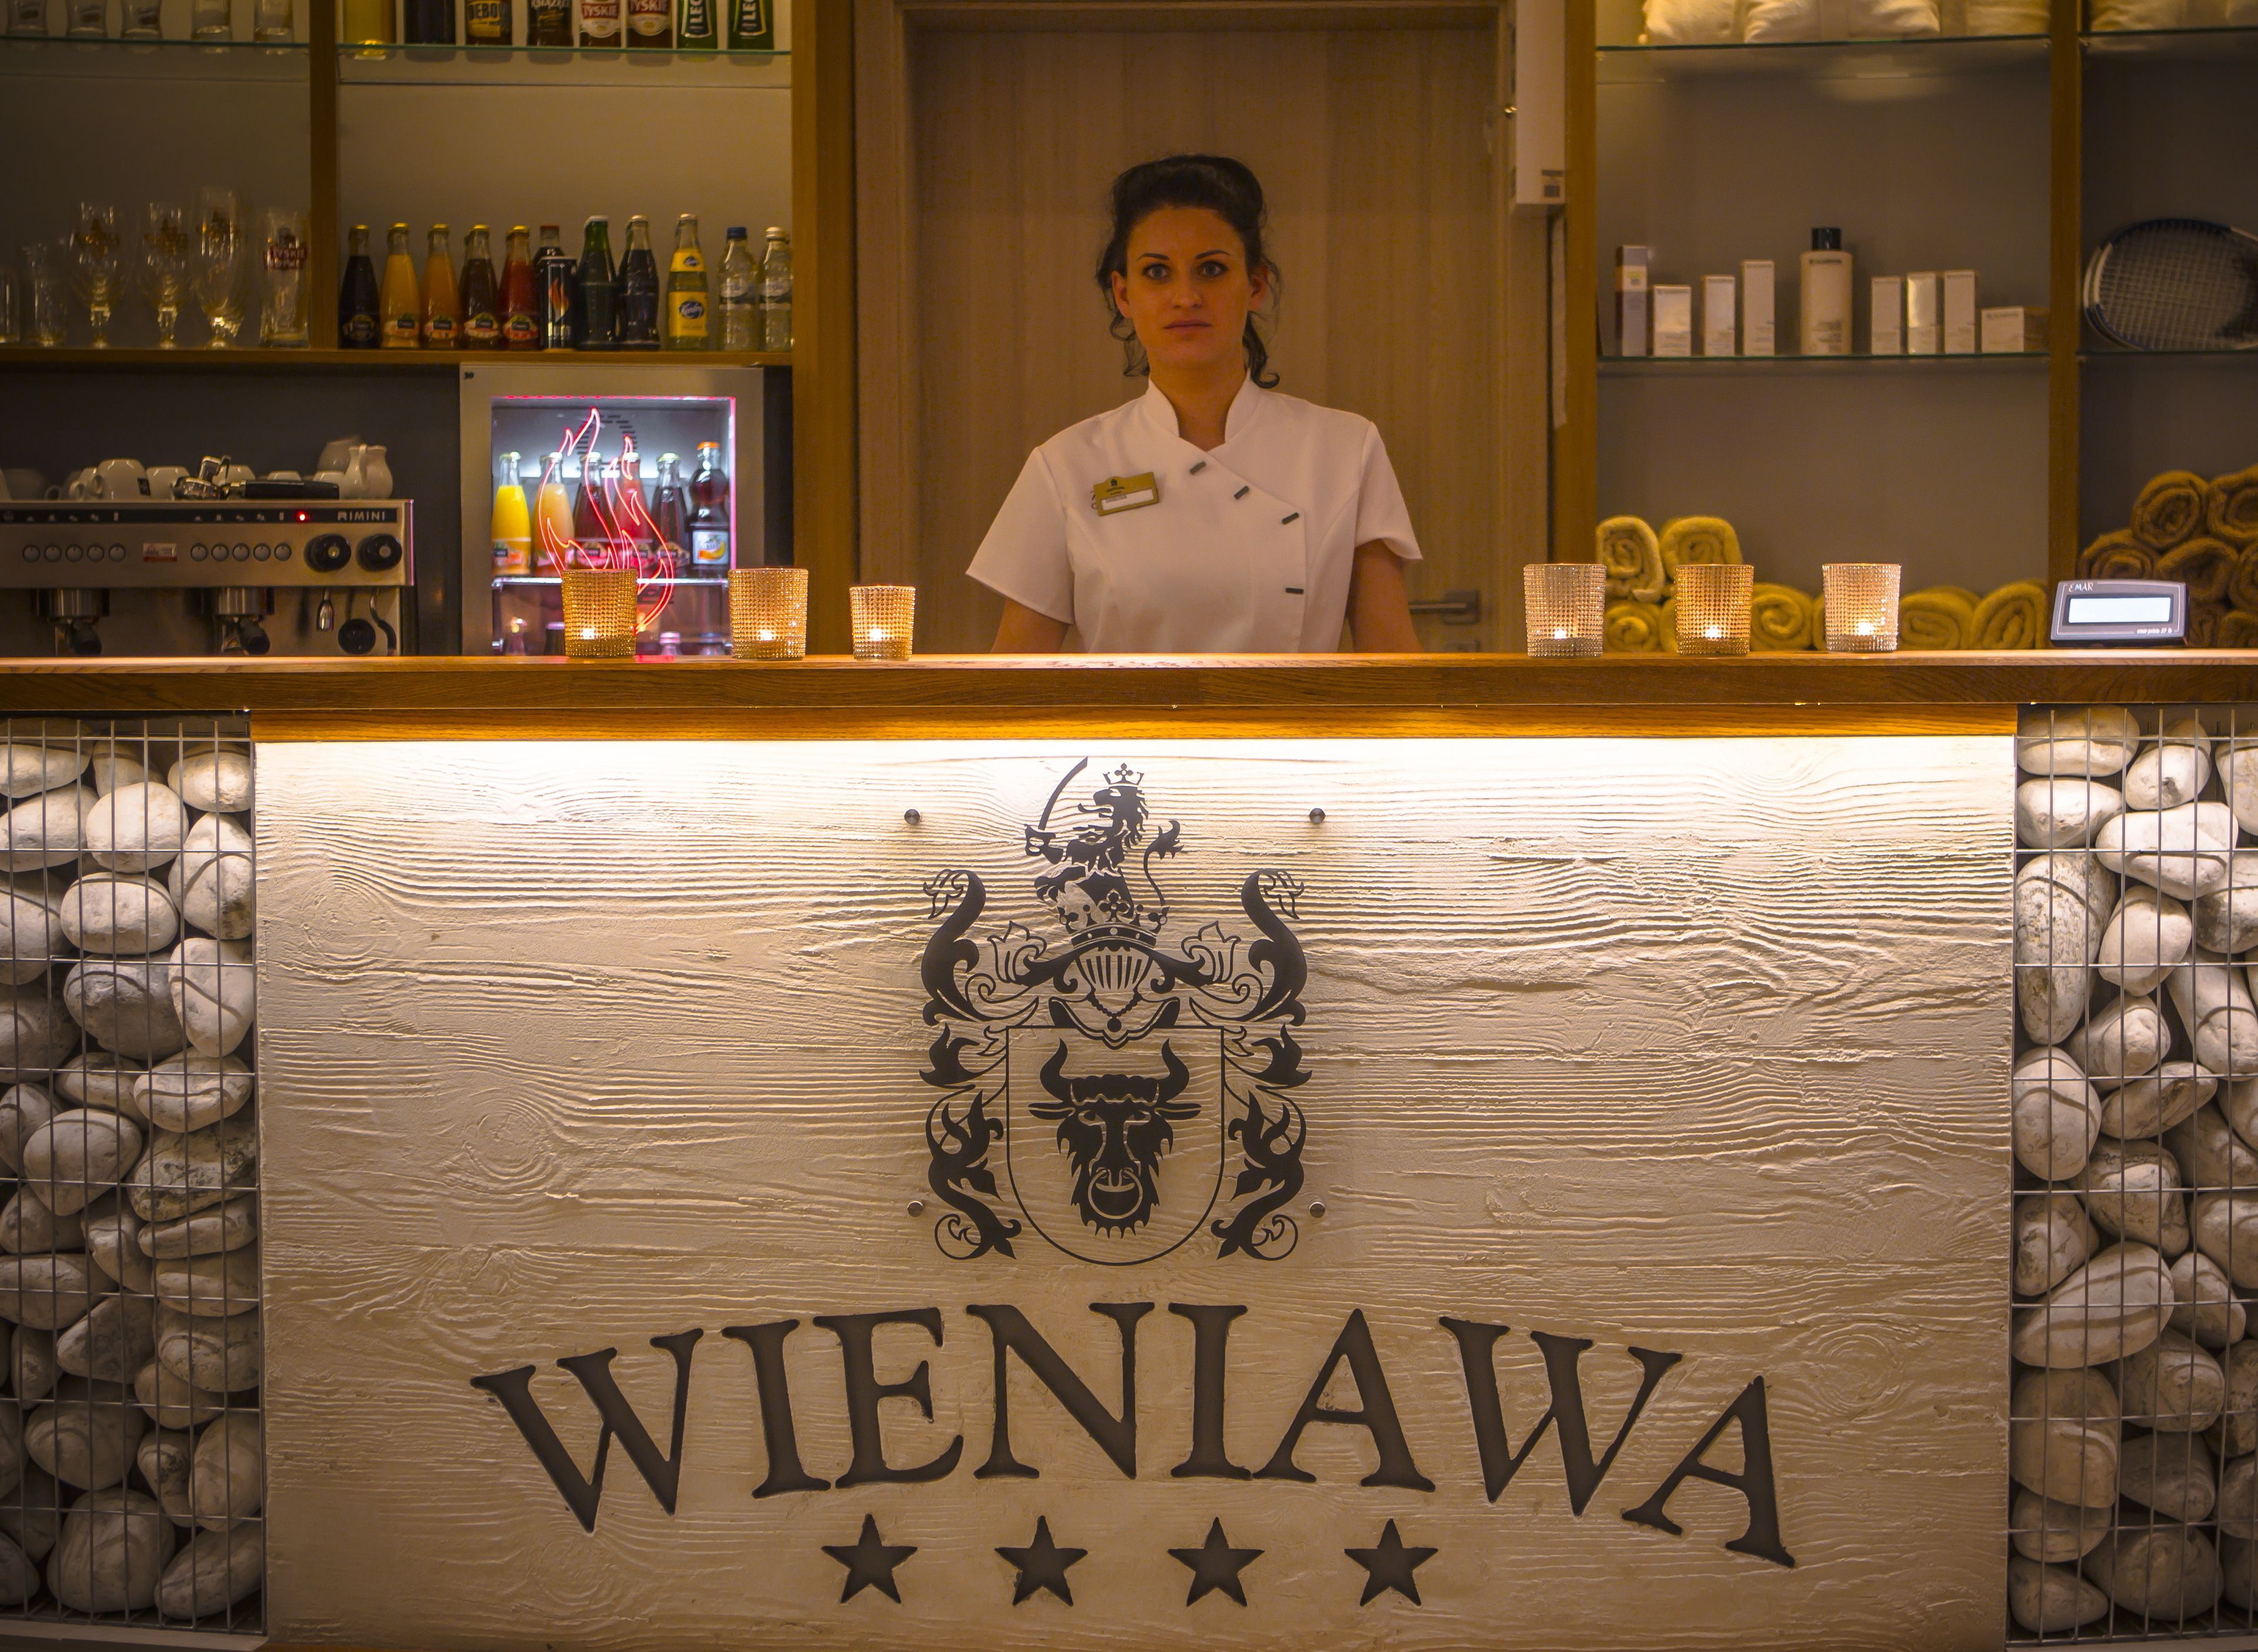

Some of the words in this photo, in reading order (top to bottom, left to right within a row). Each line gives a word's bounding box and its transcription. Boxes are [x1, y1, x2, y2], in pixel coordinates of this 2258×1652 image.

[582, 5, 617, 17] TYSKIE
[629, 0, 669, 13] TYSKIE
[338, 510, 385, 521] RIMINI
[470, 1302, 1795, 1569] WIENIAWA
